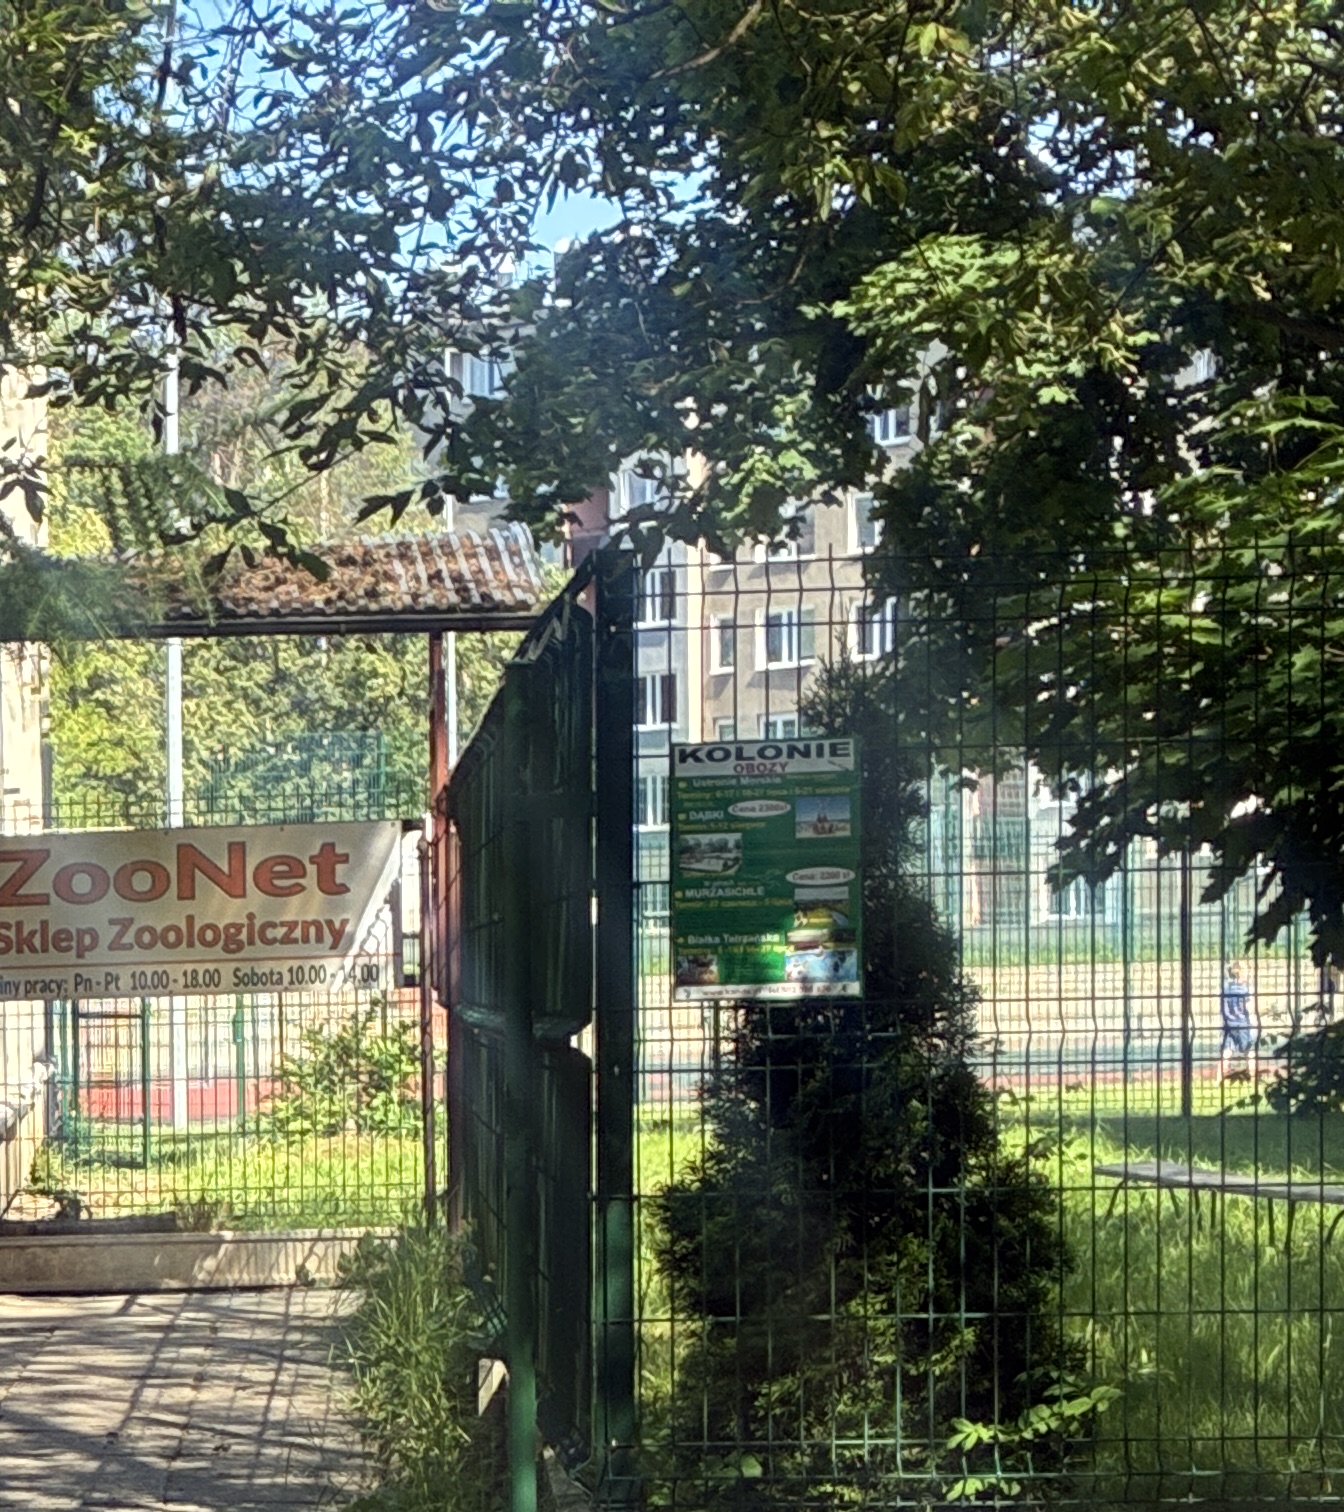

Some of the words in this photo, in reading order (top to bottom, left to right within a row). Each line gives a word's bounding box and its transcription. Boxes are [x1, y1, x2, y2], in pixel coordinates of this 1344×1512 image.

[678, 741, 851, 765] KOLONIE
[733, 761, 789, 774] OBOZY
[740, 775, 782, 786] Morskie
[731, 804, 757, 814] Cena
[689, 810, 724, 822] DĄBKI
[685, 887, 765, 899] MURZASICHLE
[107, 911, 350, 954] Zoologiczny
[24, 978, 68, 997] pracy:
[130, 970, 170, 991] 10.00
[182, 968, 221, 989] 18.00
[232, 966, 283, 988] Sobota
[287, 964, 327, 985] 10.00
